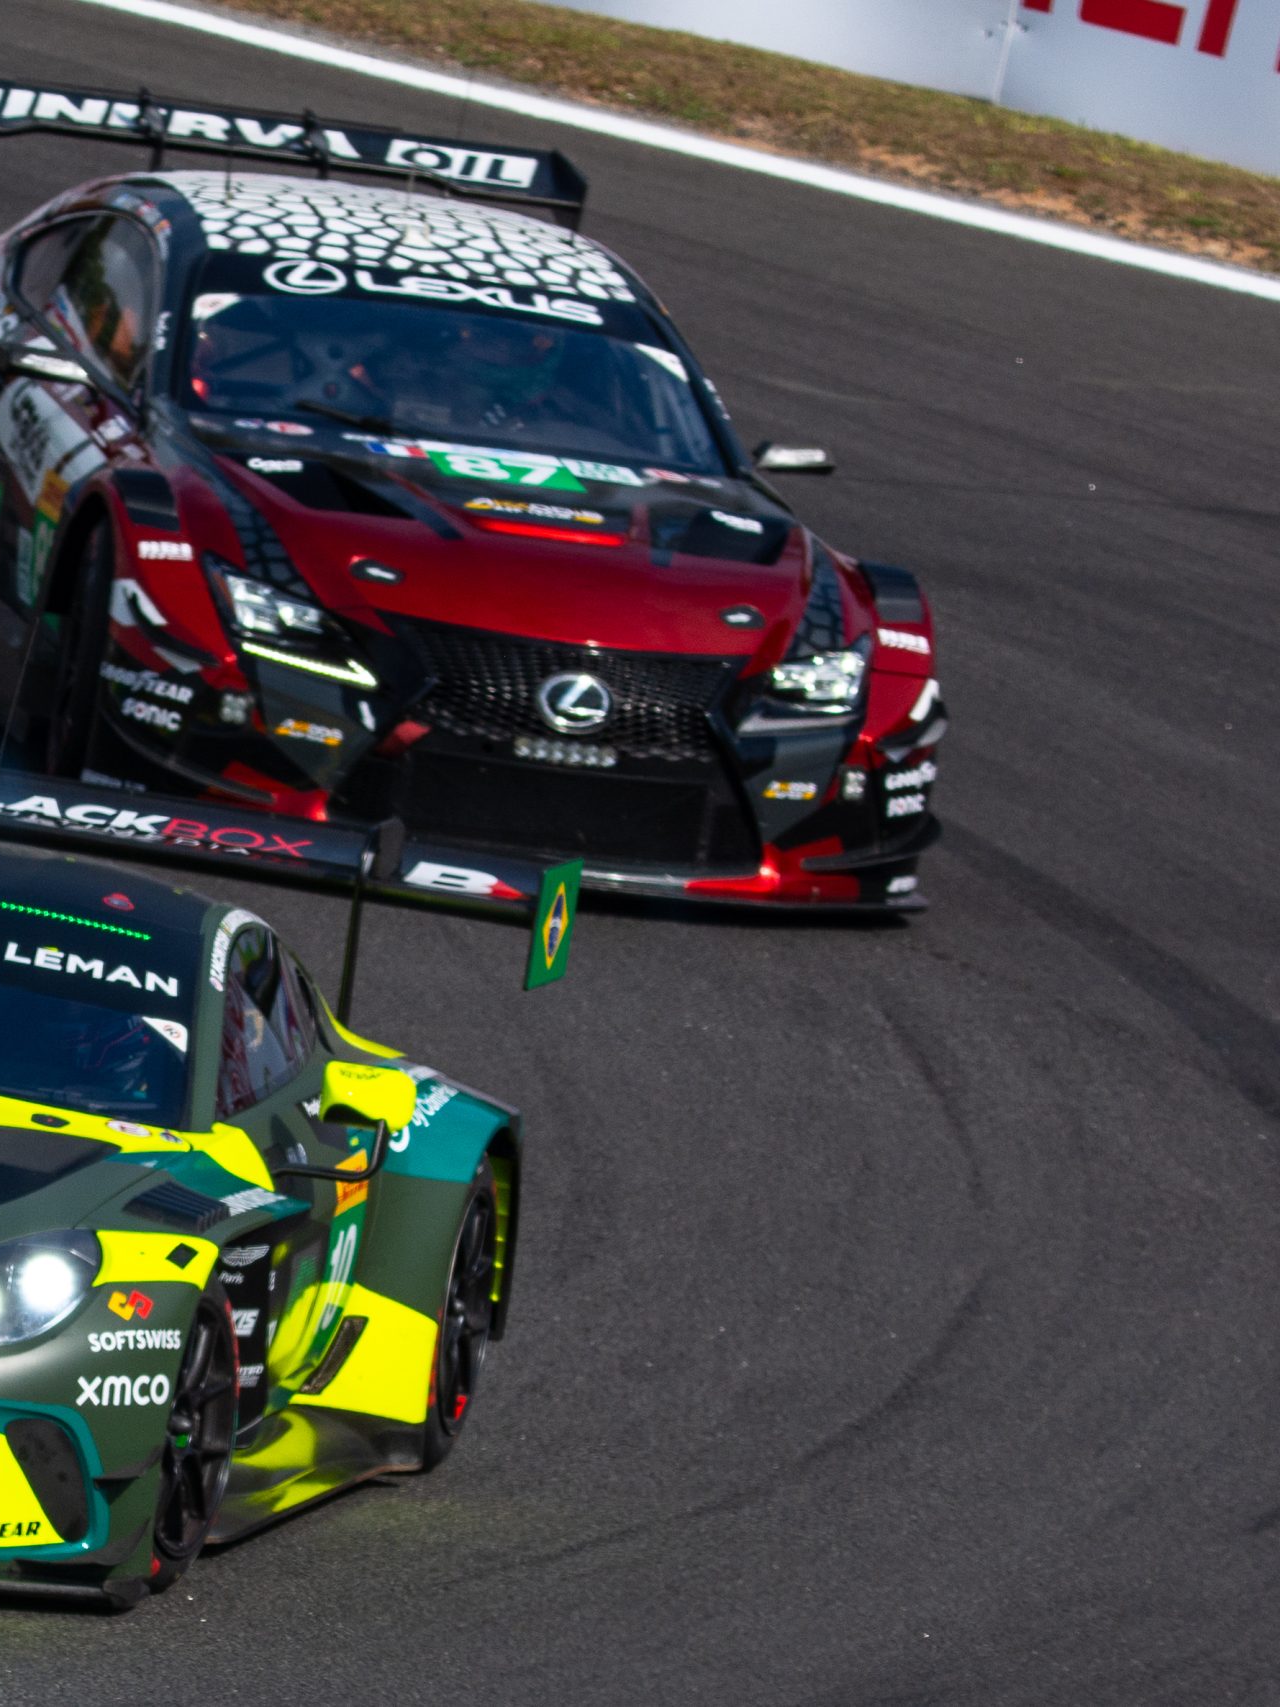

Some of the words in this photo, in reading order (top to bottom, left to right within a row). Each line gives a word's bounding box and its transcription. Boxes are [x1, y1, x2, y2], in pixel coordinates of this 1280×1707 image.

[398, 144, 529, 187] OIL
[354, 268, 605, 327] LEXUS
[443, 453, 559, 486] 87
[88, 1328, 182, 1353] SOFTSWISS
